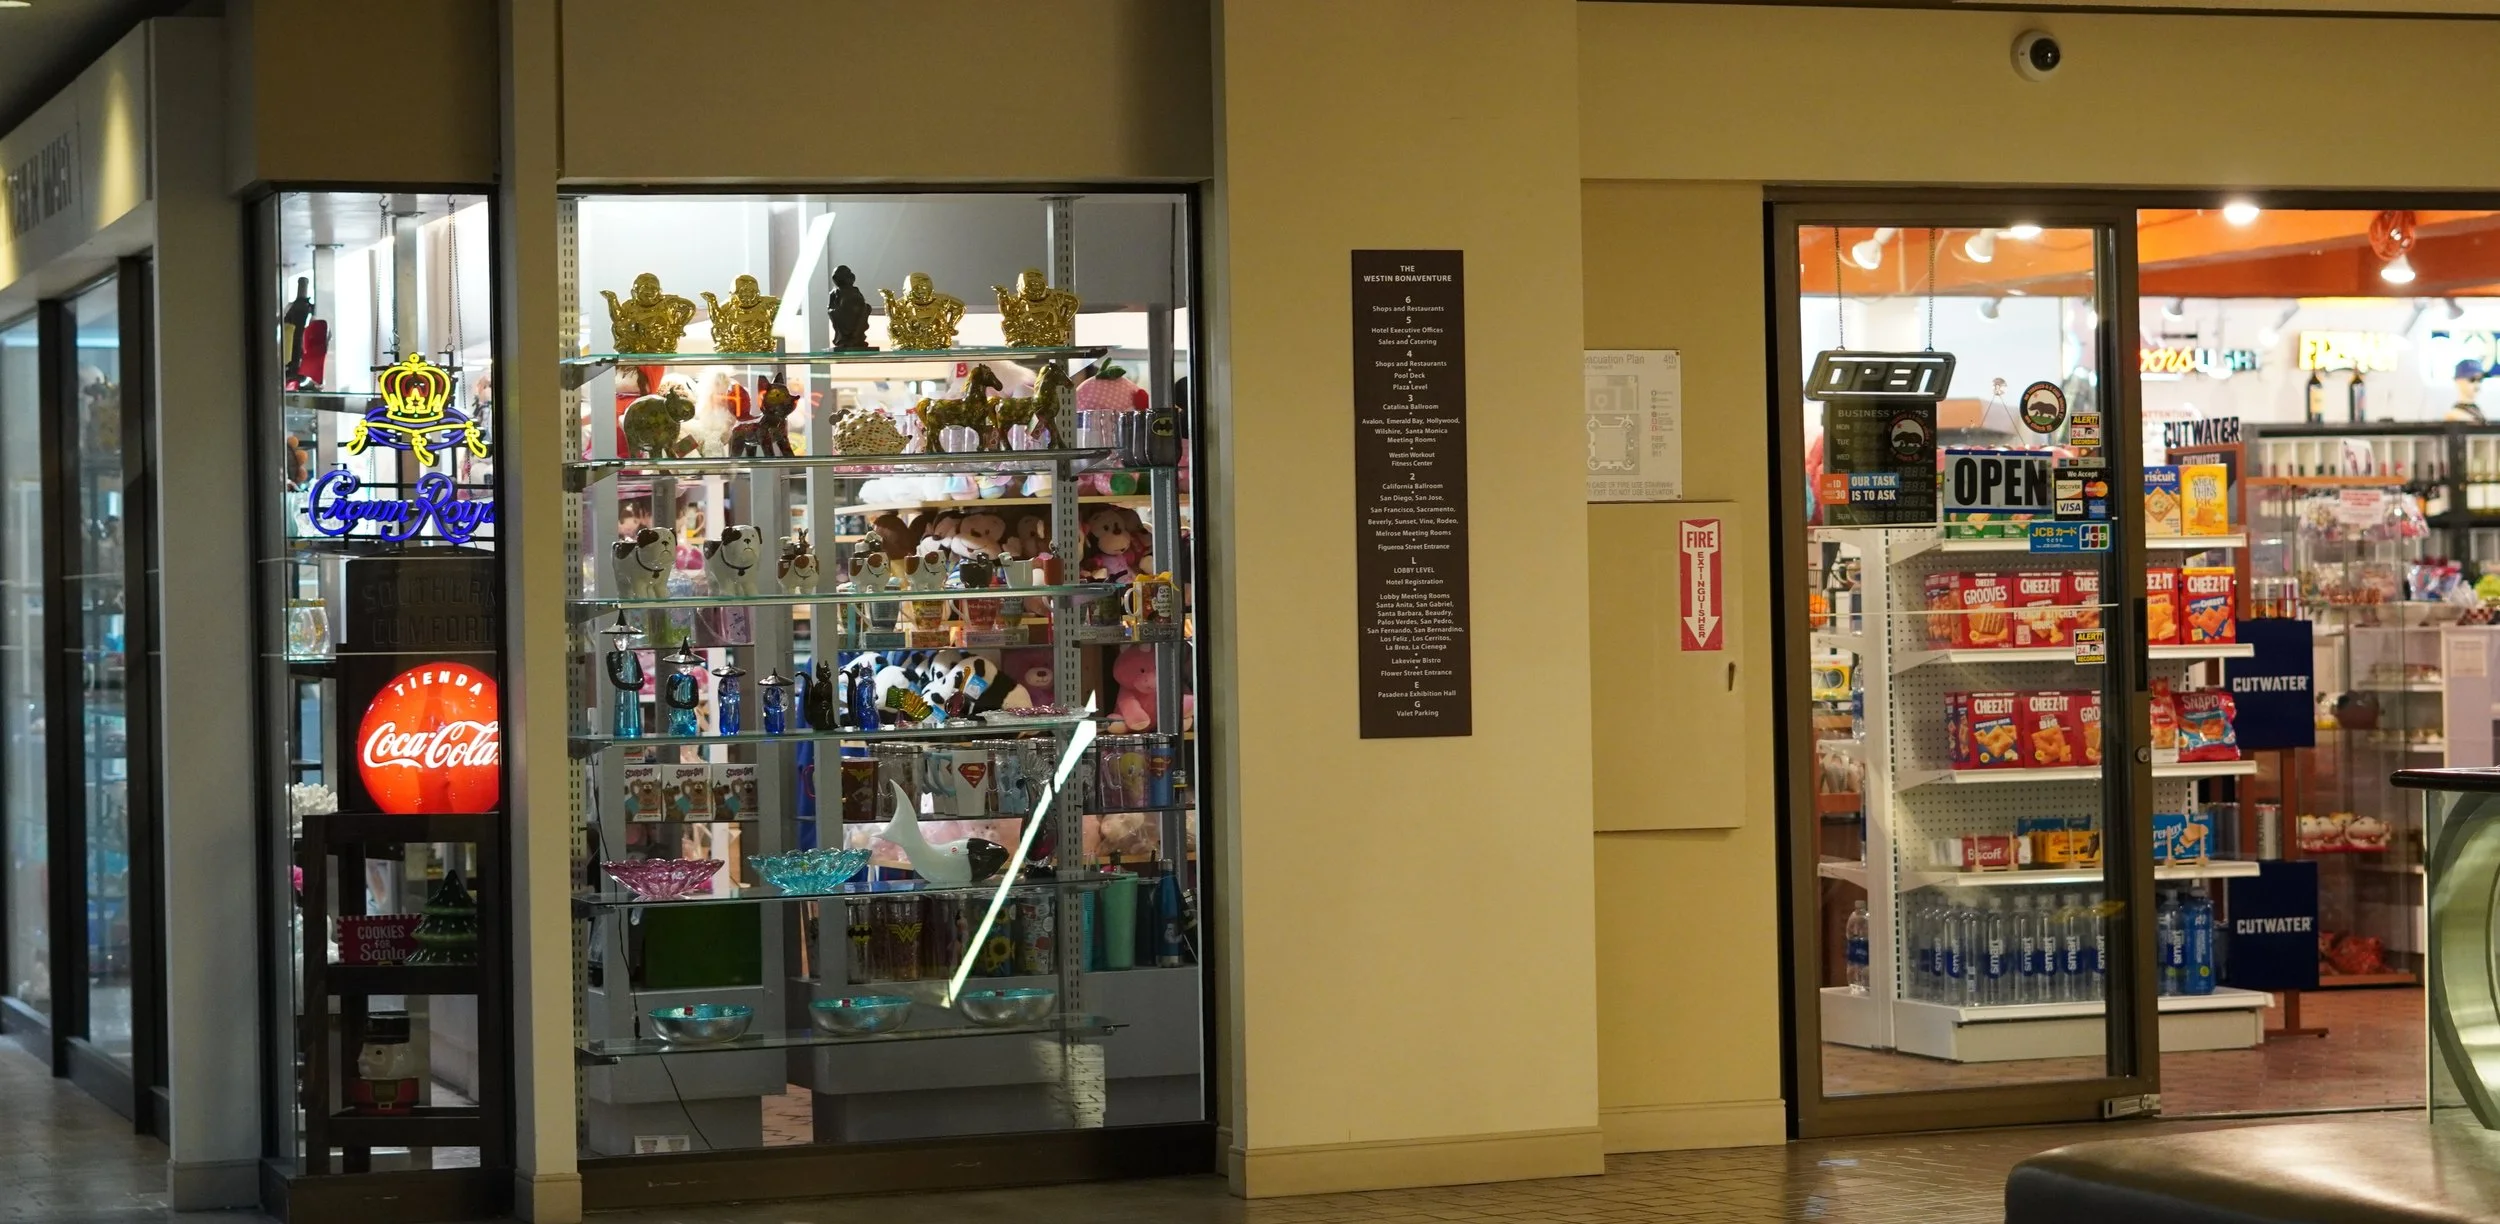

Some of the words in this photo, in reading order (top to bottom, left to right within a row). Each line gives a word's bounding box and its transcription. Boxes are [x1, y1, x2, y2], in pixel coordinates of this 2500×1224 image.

[1627, 354, 1645, 364] Plan
[1663, 354, 1676, 364] 4th
[2141, 347, 2194, 372] oors
[1822, 361, 1944, 393] OPEN
[2164, 417, 2239, 446] CUTWATER
[1851, 476, 1869, 486] OUR
[1872, 476, 1895, 486] TASK
[1954, 457, 2047, 506] OPEN
[2144, 470, 2176, 482] riscuit
[1833, 480, 1841, 488] ID
[1836, 491, 1845, 499] 30
[1852, 491, 1861, 501] IS
[1863, 491, 1874, 500] TO
[1877, 490, 1896, 500] ASK
[309, 470, 409, 536] Crown
[381, 472, 494, 544] Roya
[2060, 503, 2081, 511] VISA
[2032, 527, 2054, 537] JCB
[2056, 526, 2077, 537] カード
[2081, 532, 2107, 541] JCB
[1686, 531, 1714, 548] FIRE
[1411, 556, 1417, 564] L
[2020, 579, 2061, 594] CHEEZ-IT
[2187, 575, 2230, 592] CHEEZ-IT
[1698, 551, 1706, 638] EXTINGUISHER
[1964, 585, 2007, 605] GROOVES
[2078, 632, 2102, 641] ALERT!
[394, 671, 482, 696] TIENDA
[2232, 676, 2306, 693] CUTWATER
[1974, 698, 2014, 714] CHEEZ-IT
[2030, 696, 2069, 711] CHEEZ-IT
[363, 720, 498, 768] Coca-Cola
[1968, 847, 2002, 860] Bscoff
[358, 926, 404, 939] COOKIES
[2237, 917, 2311, 934] CUTWATER
[375, 940, 390, 948] FOR
[2173, 930, 2182, 964] smart
[360, 944, 406, 961] Santa
